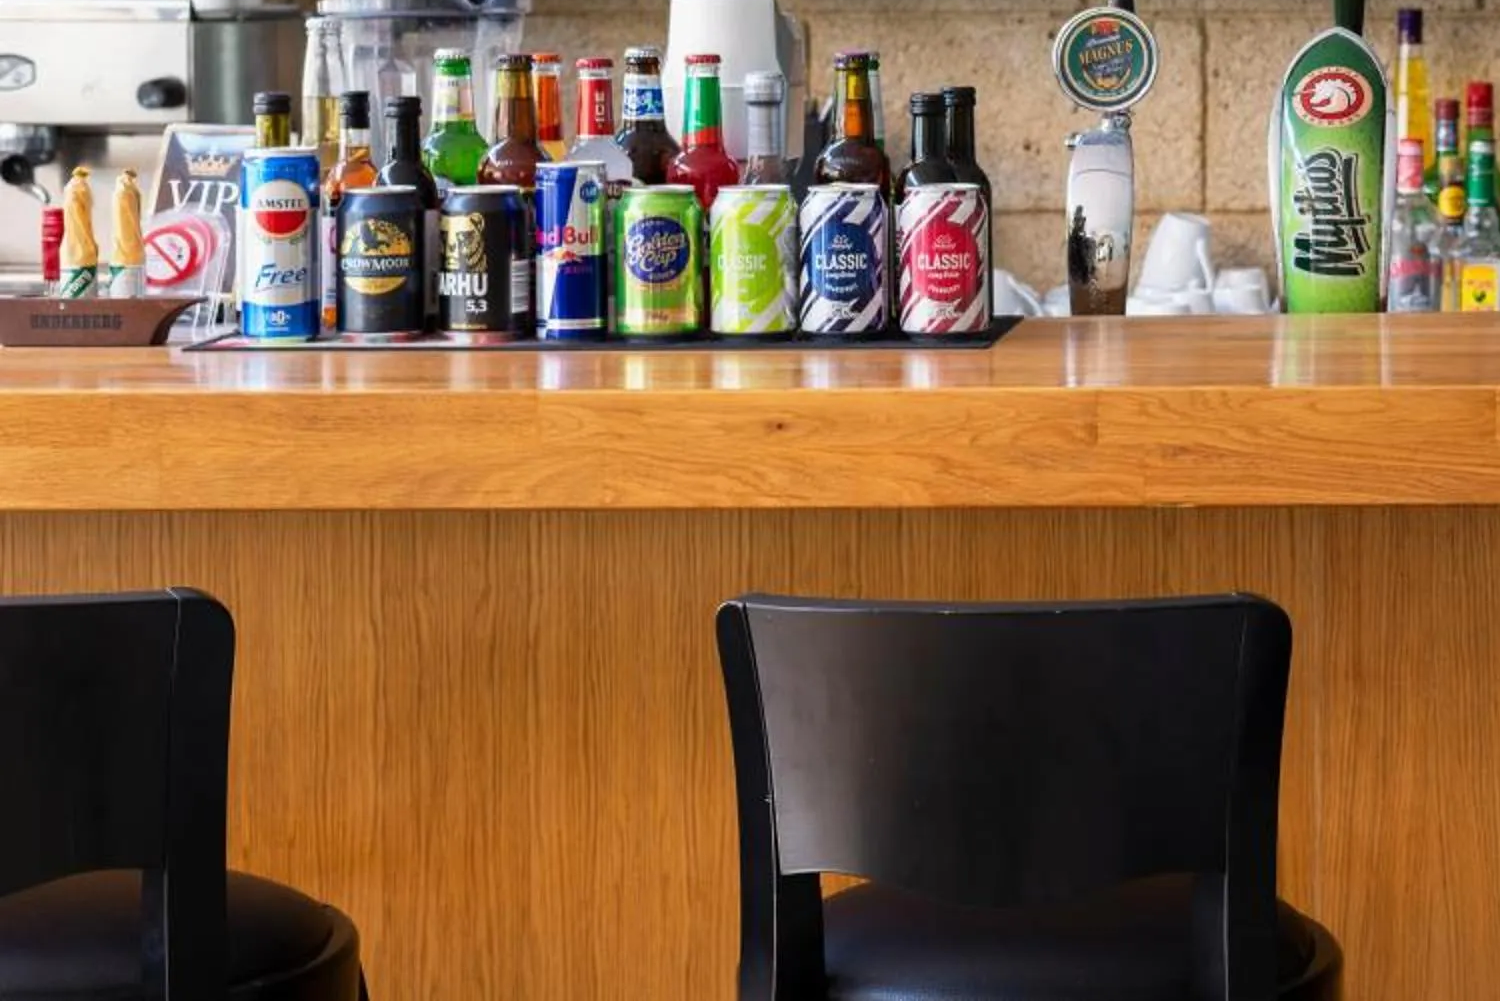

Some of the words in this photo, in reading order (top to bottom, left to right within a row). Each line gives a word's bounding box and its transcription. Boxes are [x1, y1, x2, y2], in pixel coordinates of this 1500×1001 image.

[815, 252, 868, 270] CLASSIC
[917, 252, 971, 270] CLASSIC
[255, 262, 308, 289] Free
[437, 272, 489, 296] ARHU
